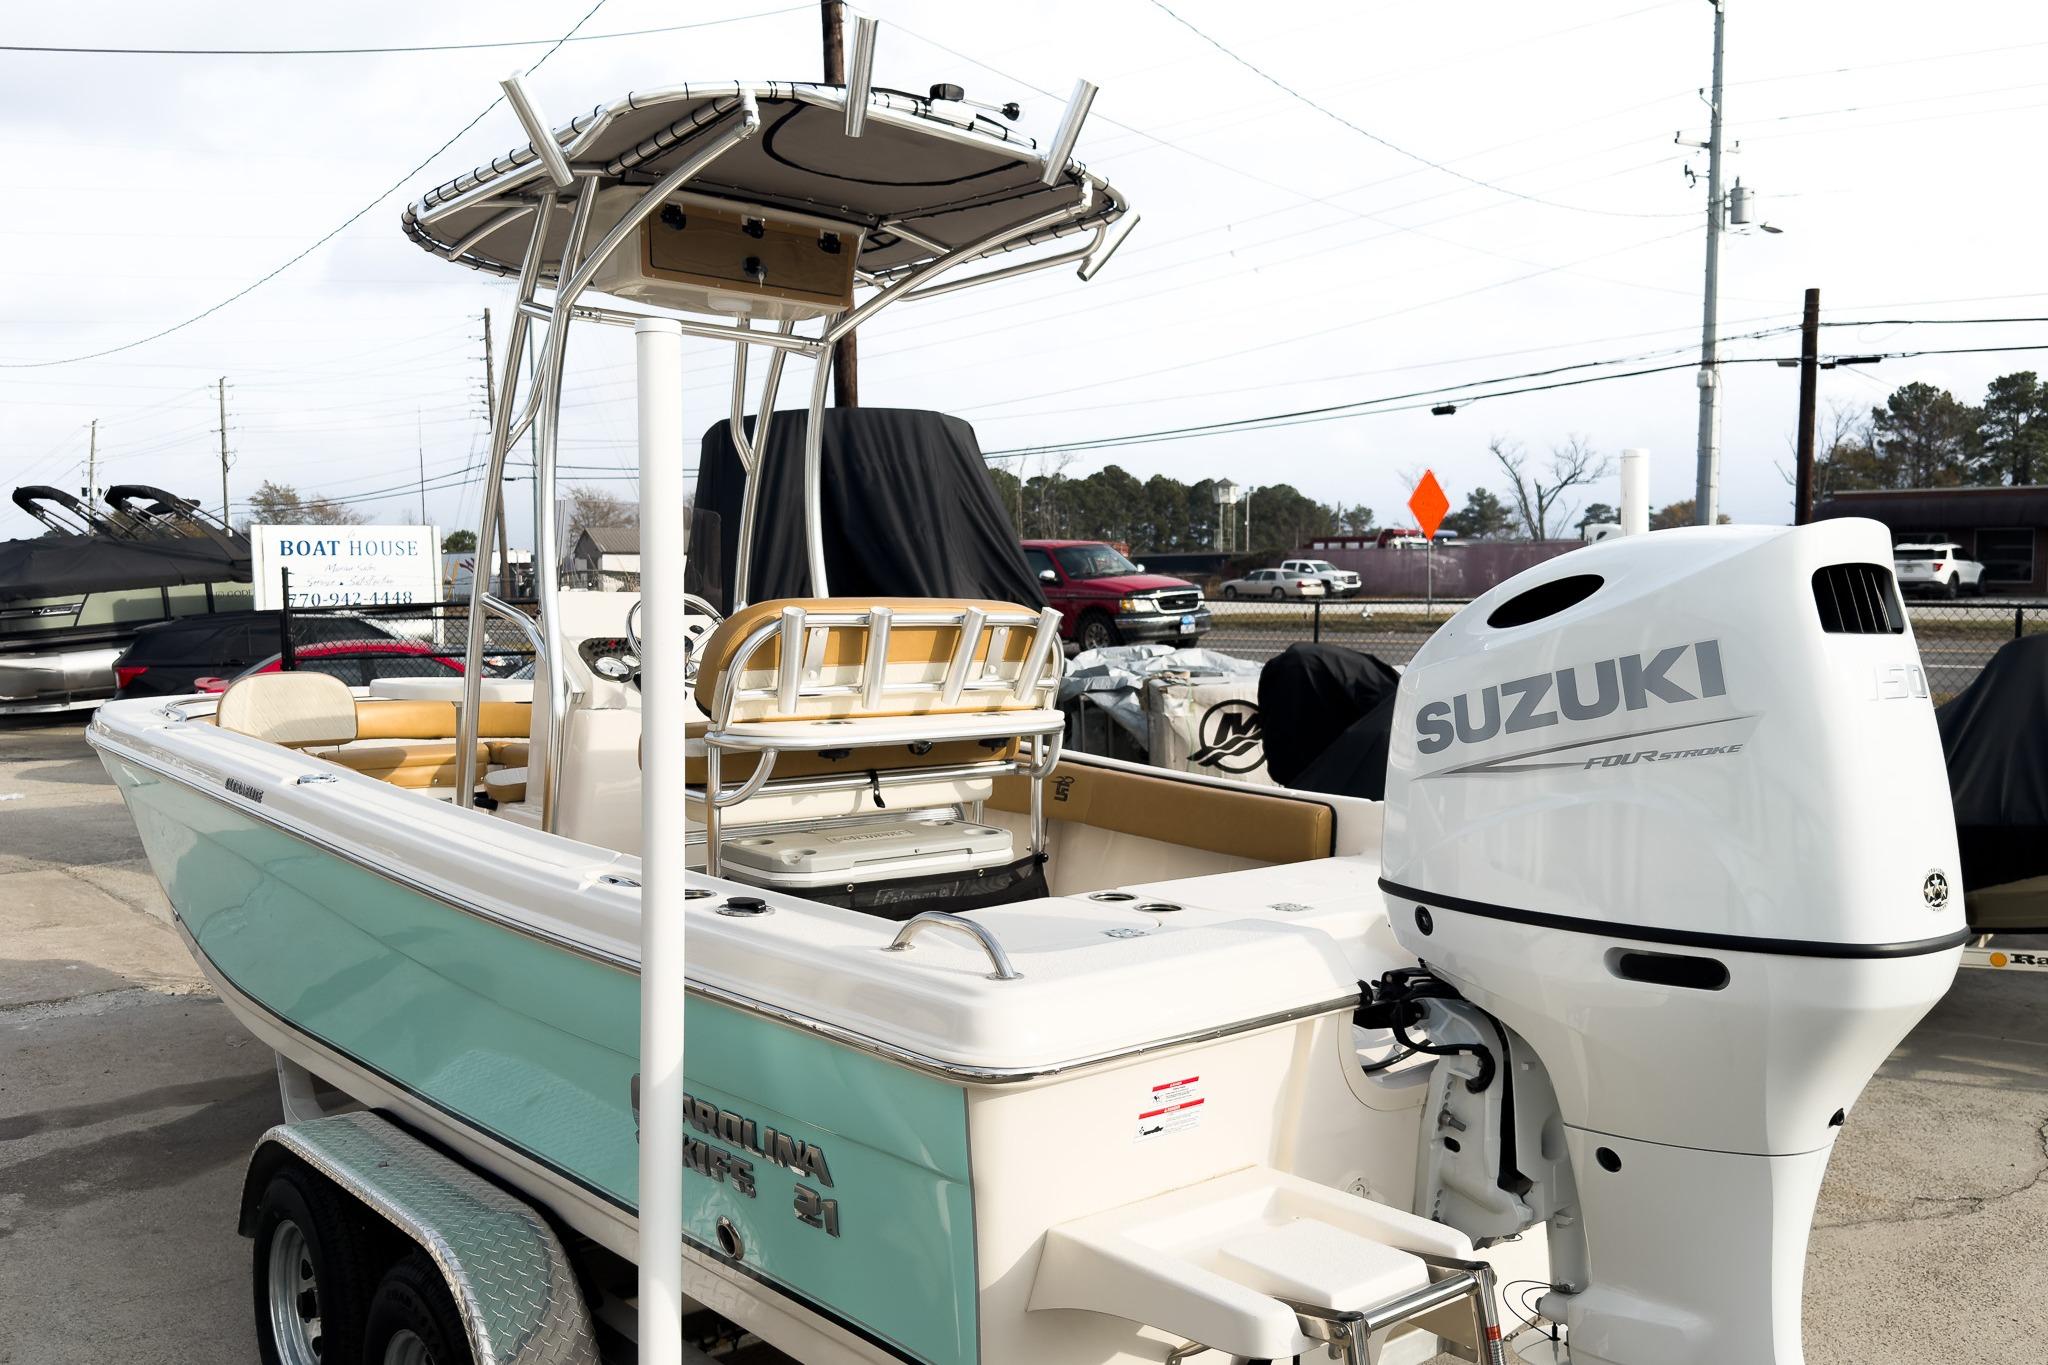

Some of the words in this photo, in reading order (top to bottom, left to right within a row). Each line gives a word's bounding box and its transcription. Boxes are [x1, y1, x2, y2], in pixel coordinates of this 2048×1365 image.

[280, 540, 341, 556] BOAT
[349, 540, 419, 556] HOUSE
[1416, 639, 1727, 755] SUZUKI
[793, 1182, 841, 1238] 21
